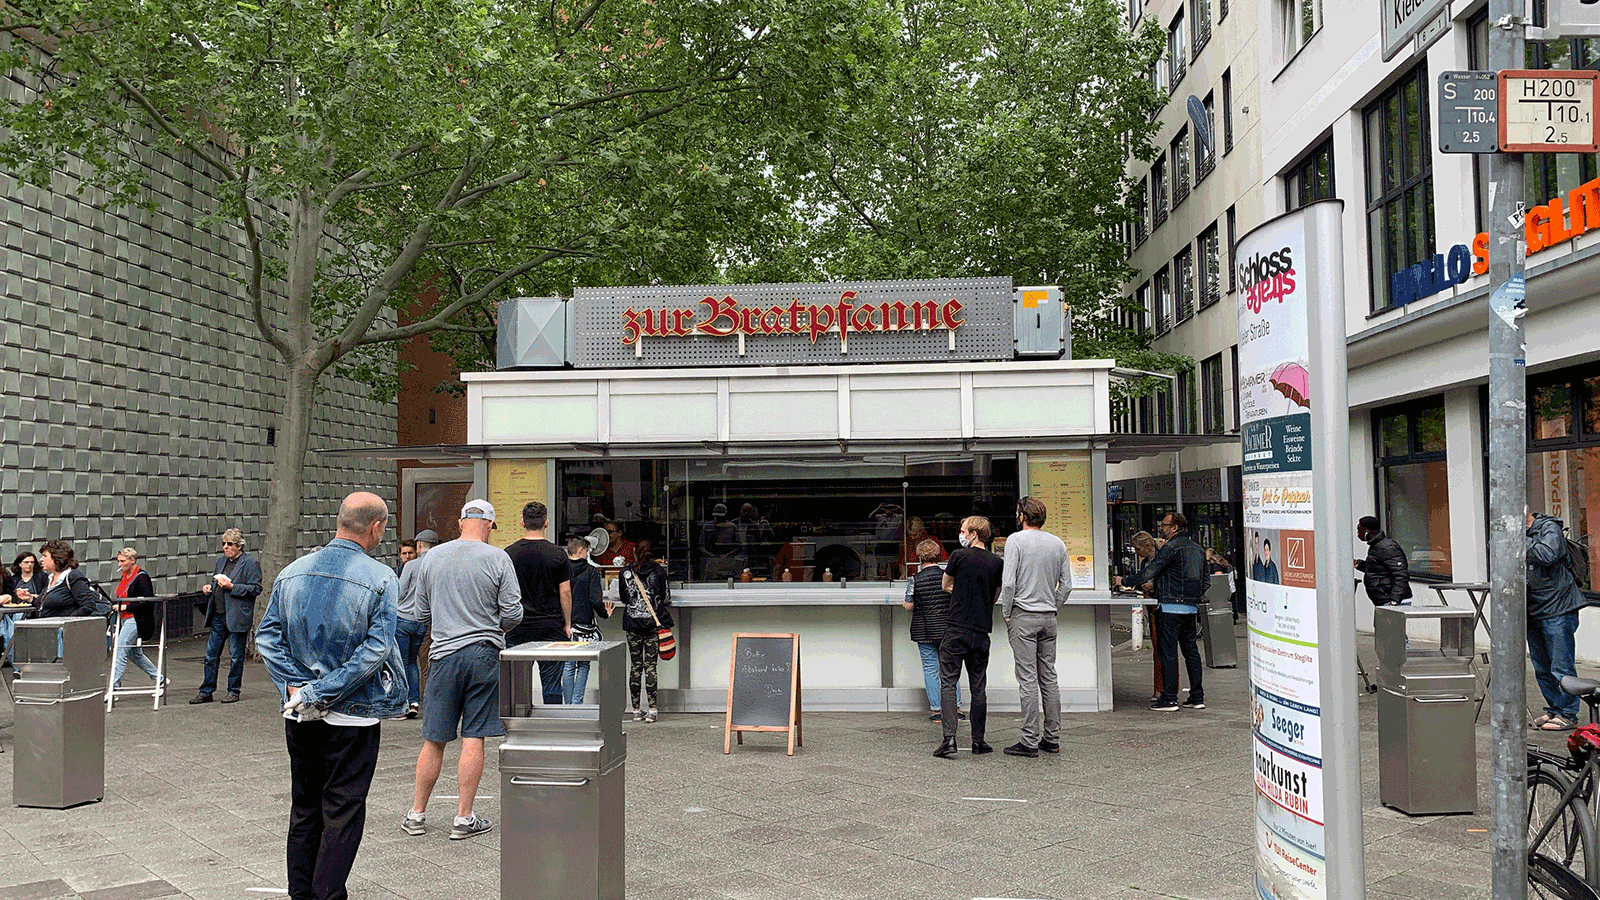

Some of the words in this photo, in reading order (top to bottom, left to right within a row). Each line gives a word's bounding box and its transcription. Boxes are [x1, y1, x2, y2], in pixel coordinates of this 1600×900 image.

[1422, 31, 1427, 42] 6
[1443, 82, 1458, 100] S
[1473, 88, 1496, 101] 200
[1239, 246, 1292, 295] Schloss
[621, 305, 695, 344] zur
[694, 291, 966, 344] Bratpfanne
[1249, 318, 1270, 341] Straße
[1282, 433, 1306, 443] Eisweine
[1285, 424, 1302, 433] Weine
[1285, 443, 1304, 453] Brände
[1286, 453, 1301, 463] Sekte
[1294, 652, 1313, 664] Steglitz
[1271, 707, 1305, 743] Seeger
[1284, 790, 1309, 815] RUBIN
[1281, 827, 1297, 840] Minuten
[1305, 840, 1318, 852] hier!
[1281, 848, 1318, 877] ReiseCenter
